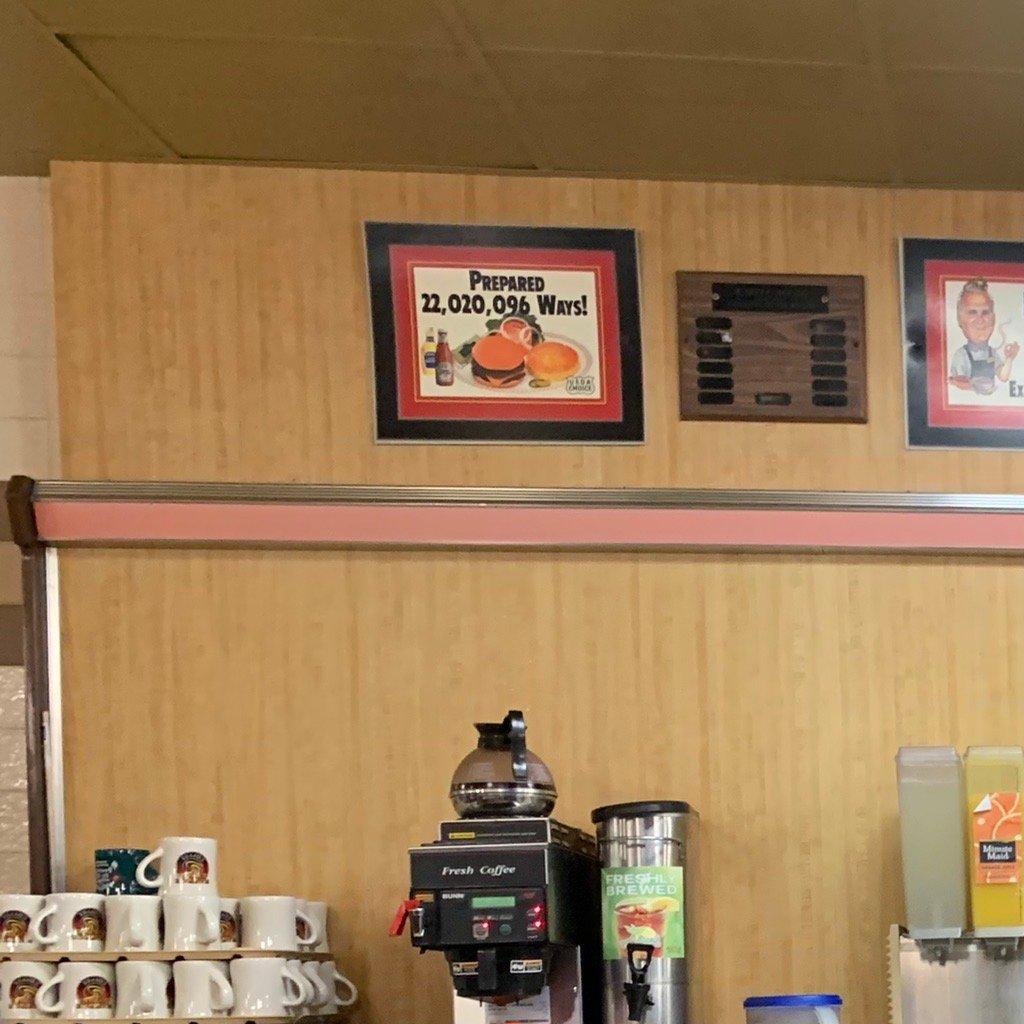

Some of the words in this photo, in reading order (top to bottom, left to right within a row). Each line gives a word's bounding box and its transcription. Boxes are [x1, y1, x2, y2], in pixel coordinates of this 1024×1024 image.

[469, 270, 545, 292] PREPARED
[421, 293, 530, 316] 22,020,096
[537, 294, 588, 316] WAYS!
[987, 852, 1010, 860] Maid
[441, 866, 474, 876] Fresh
[479, 864, 516, 877] Coffee
[605, 873, 676, 885] FRESHLY
[606, 885, 677, 896] BREWED
